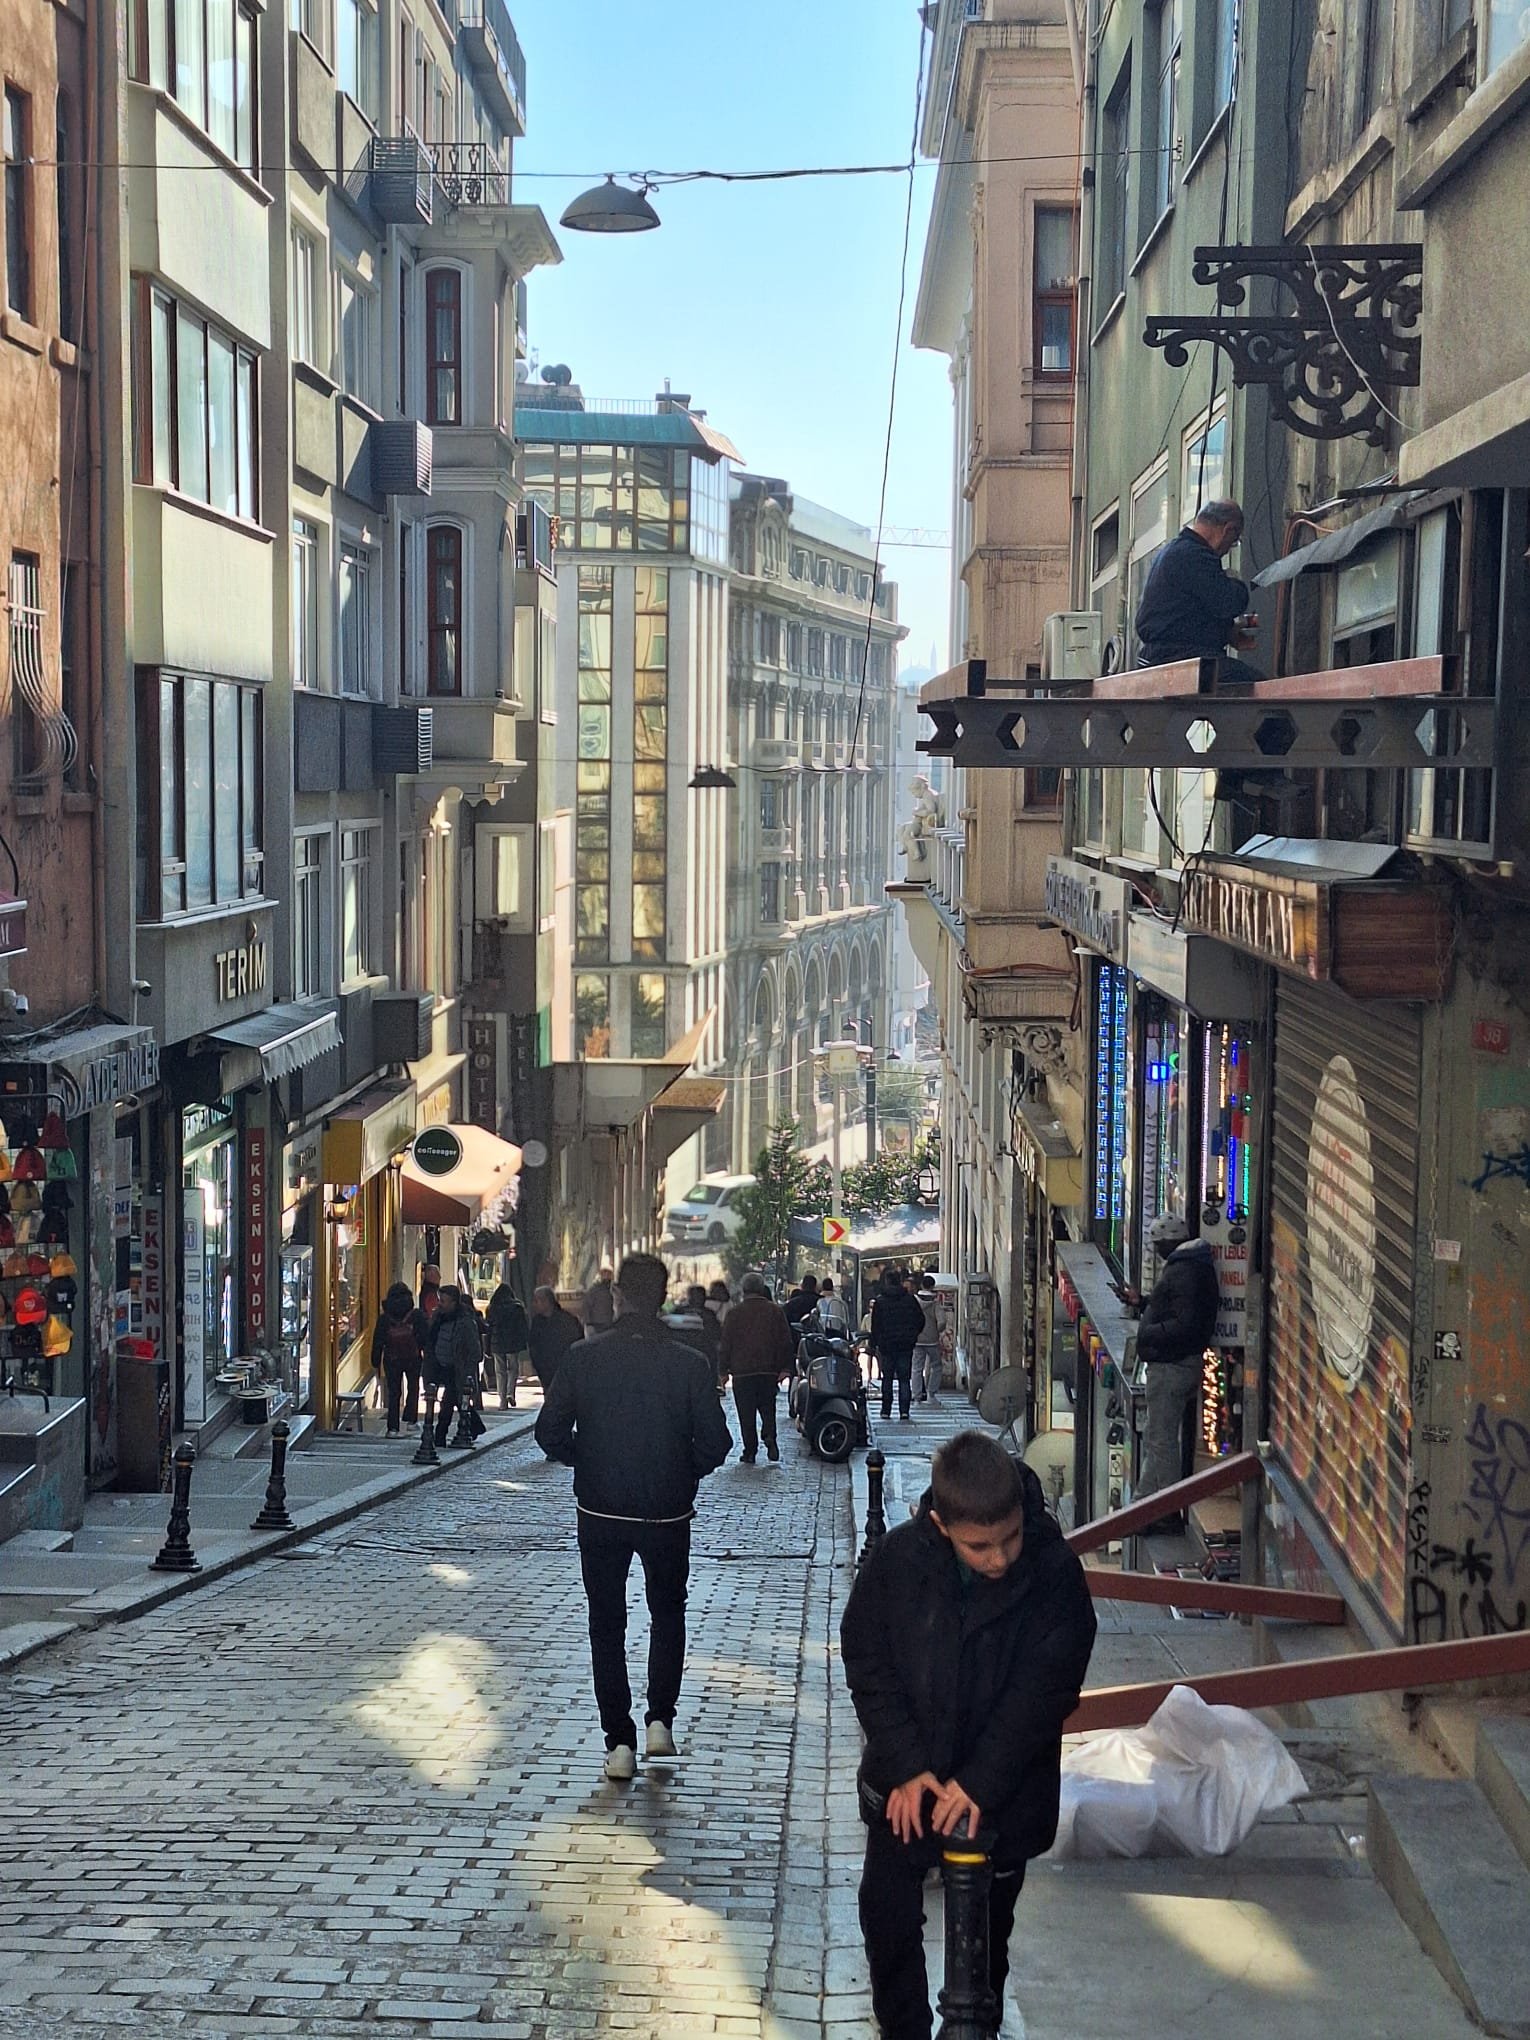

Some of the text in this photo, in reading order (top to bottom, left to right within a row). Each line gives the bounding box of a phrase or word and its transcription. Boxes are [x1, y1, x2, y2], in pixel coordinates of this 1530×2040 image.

[1219, 878, 1296, 963] REKLAM
[474, 1029, 491, 1117] HOTE
[144, 1208, 160, 1315] EKSEN
[251, 1142, 262, 1326] EKSEN UYDU
